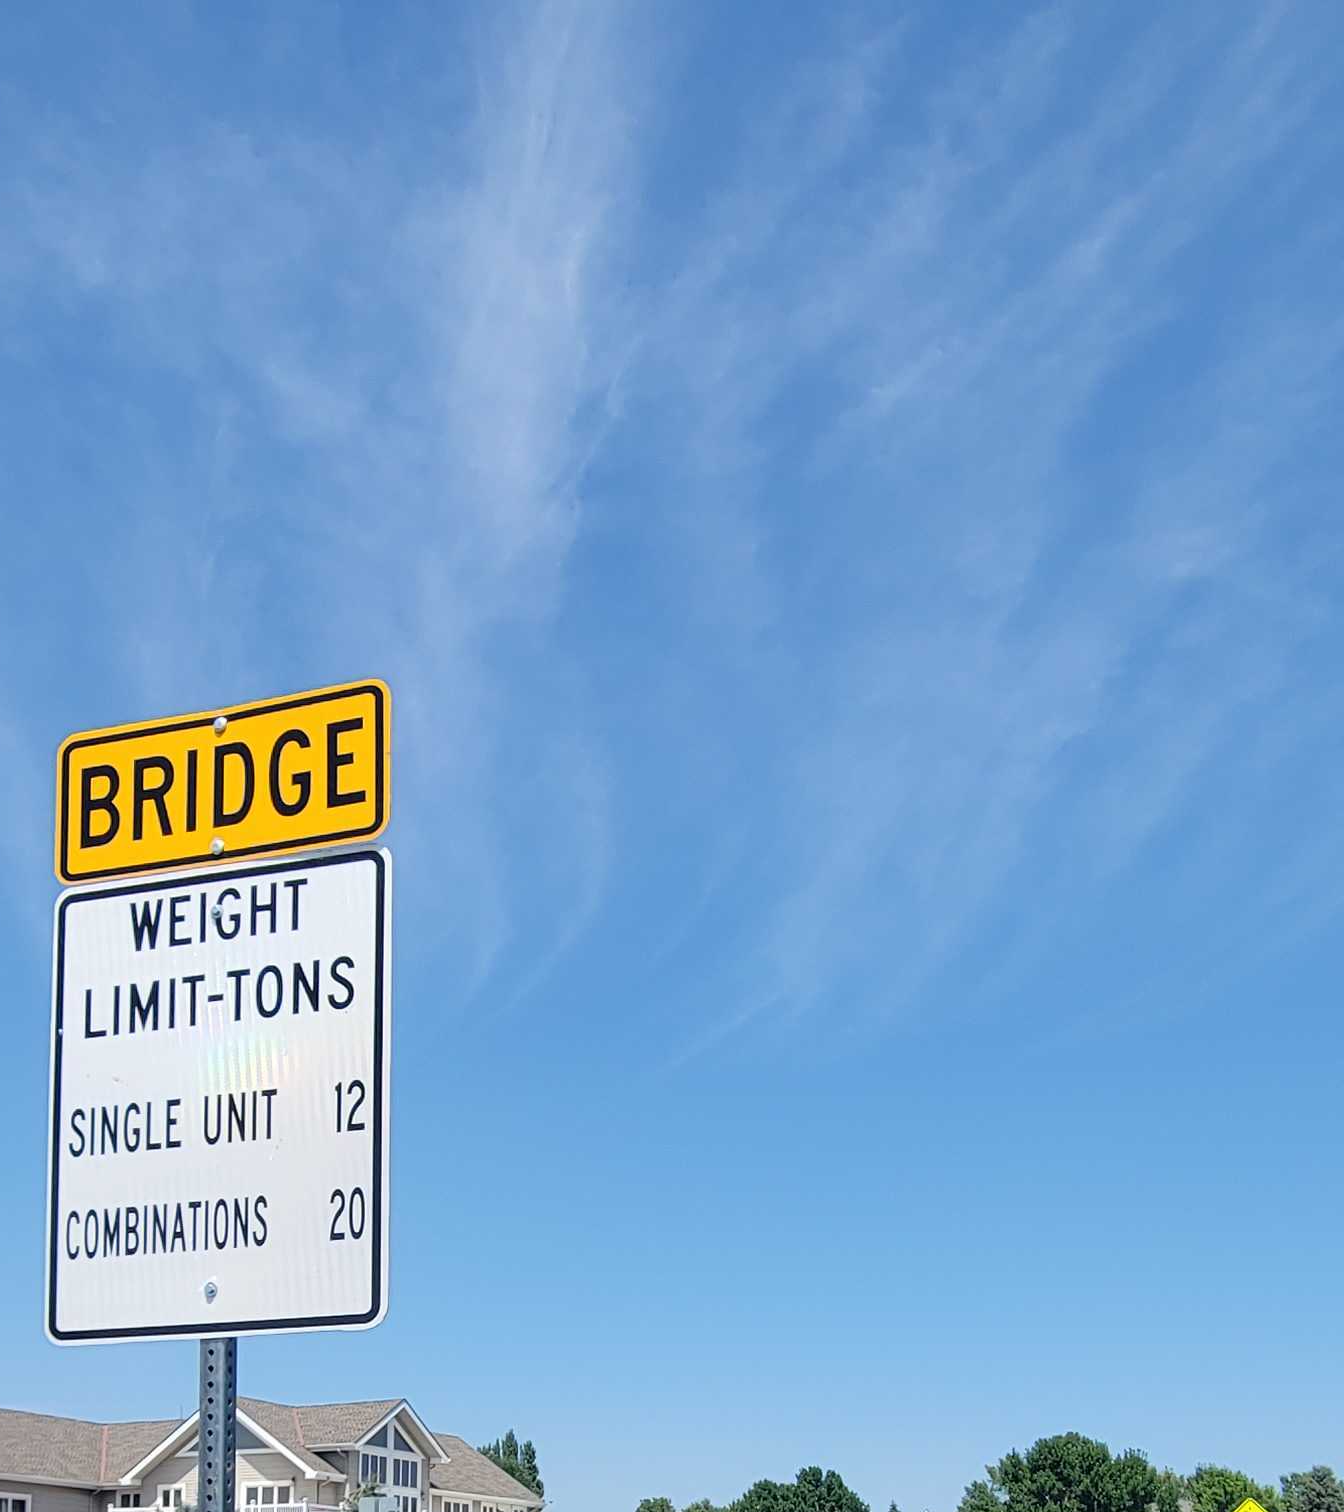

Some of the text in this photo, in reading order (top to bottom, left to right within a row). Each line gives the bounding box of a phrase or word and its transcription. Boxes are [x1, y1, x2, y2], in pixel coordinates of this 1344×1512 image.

[80, 717, 366, 849] BRIDGE
[130, 879, 307, 951] WEIGHT
[84, 956, 354, 1038] LIMIT-TONS
[69, 1080, 365, 1157] SINGLE UNIT 12
[66, 1188, 364, 1260] COMBINATIONS 20
